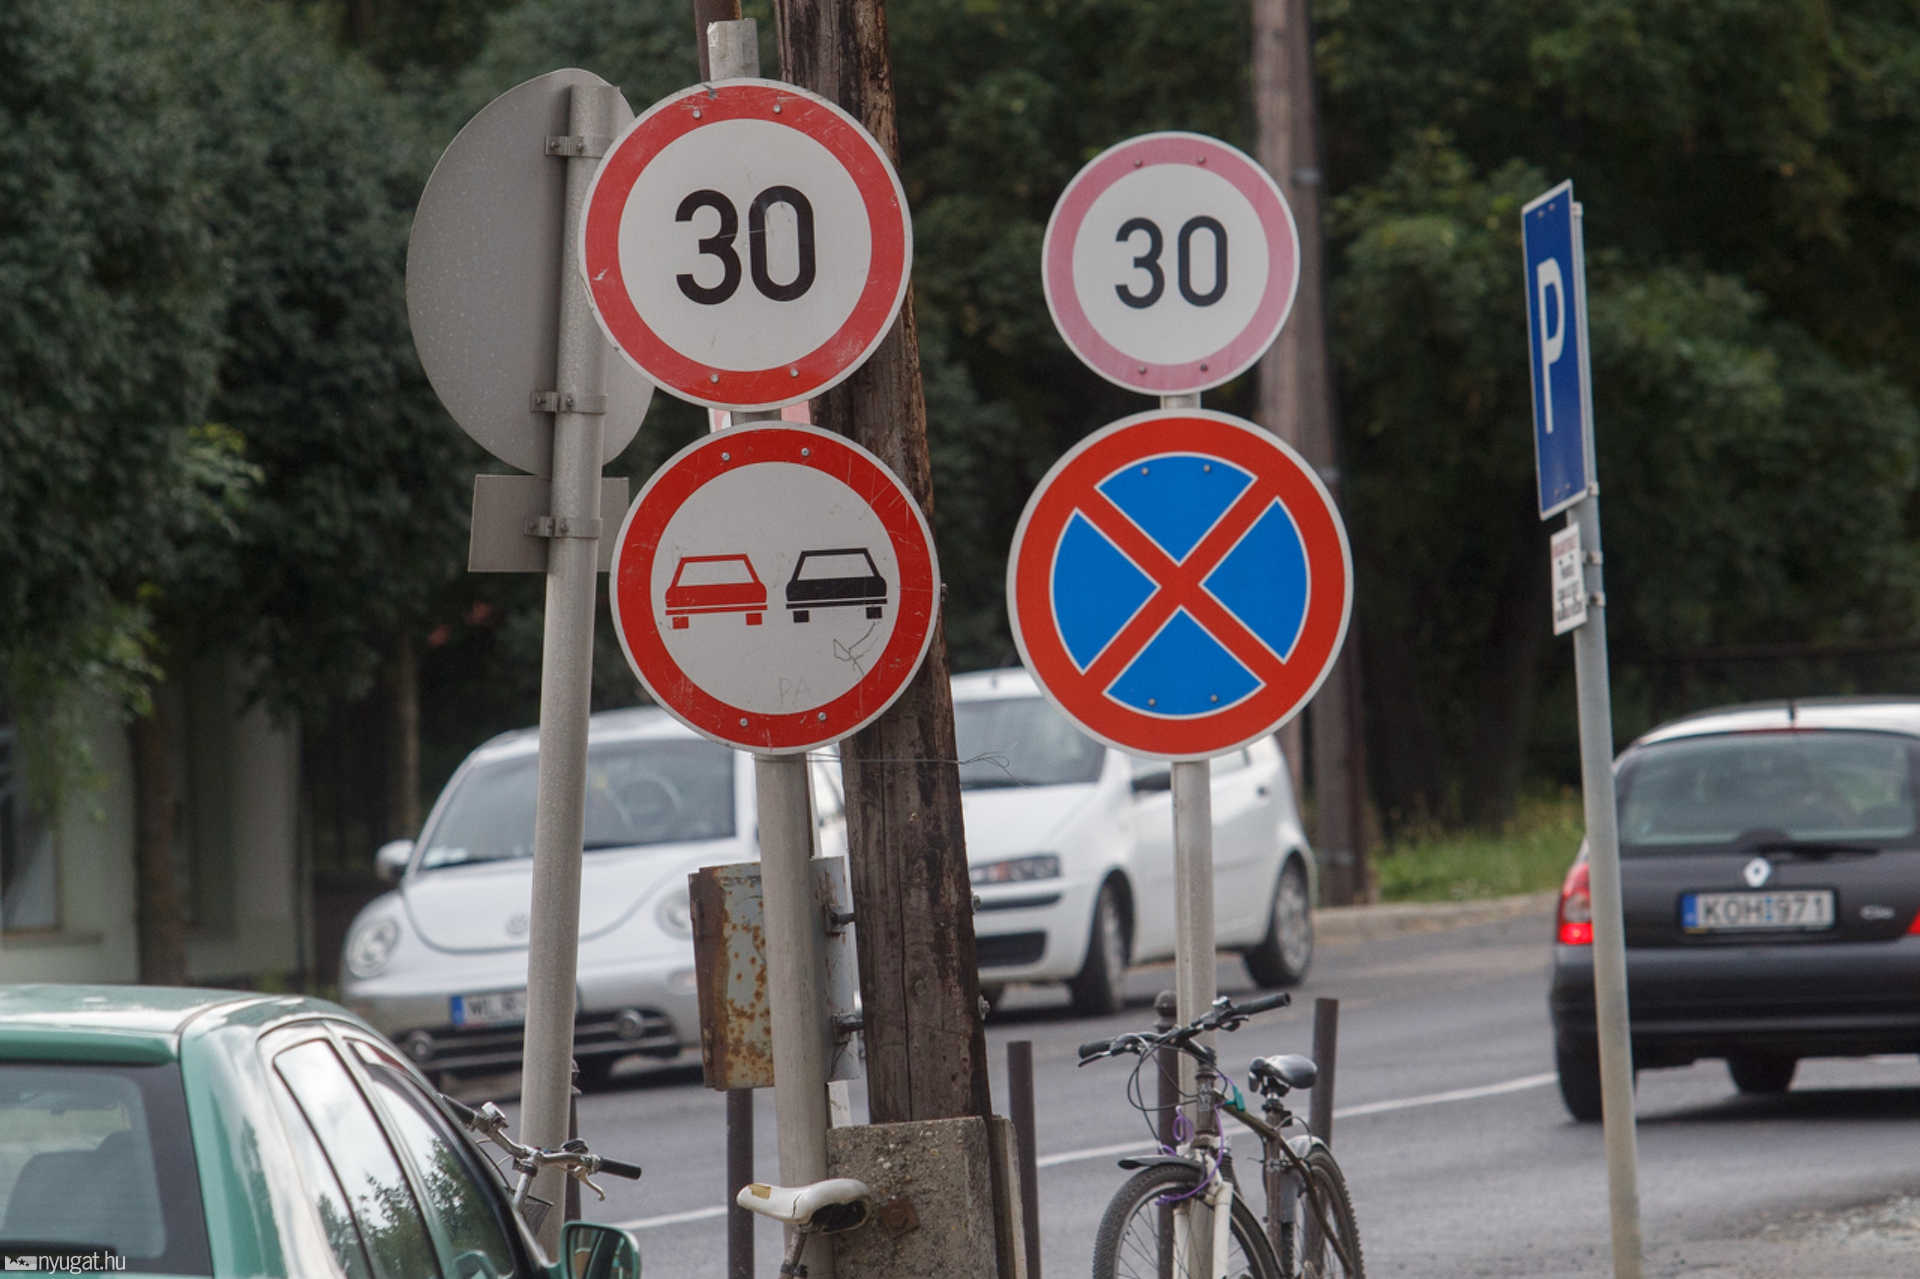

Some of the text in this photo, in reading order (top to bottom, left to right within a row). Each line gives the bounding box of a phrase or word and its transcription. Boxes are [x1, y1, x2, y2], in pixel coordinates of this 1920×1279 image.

[675, 185, 817, 305] 30
[1115, 215, 1228, 310] 30
[1537, 258, 1566, 433] P
